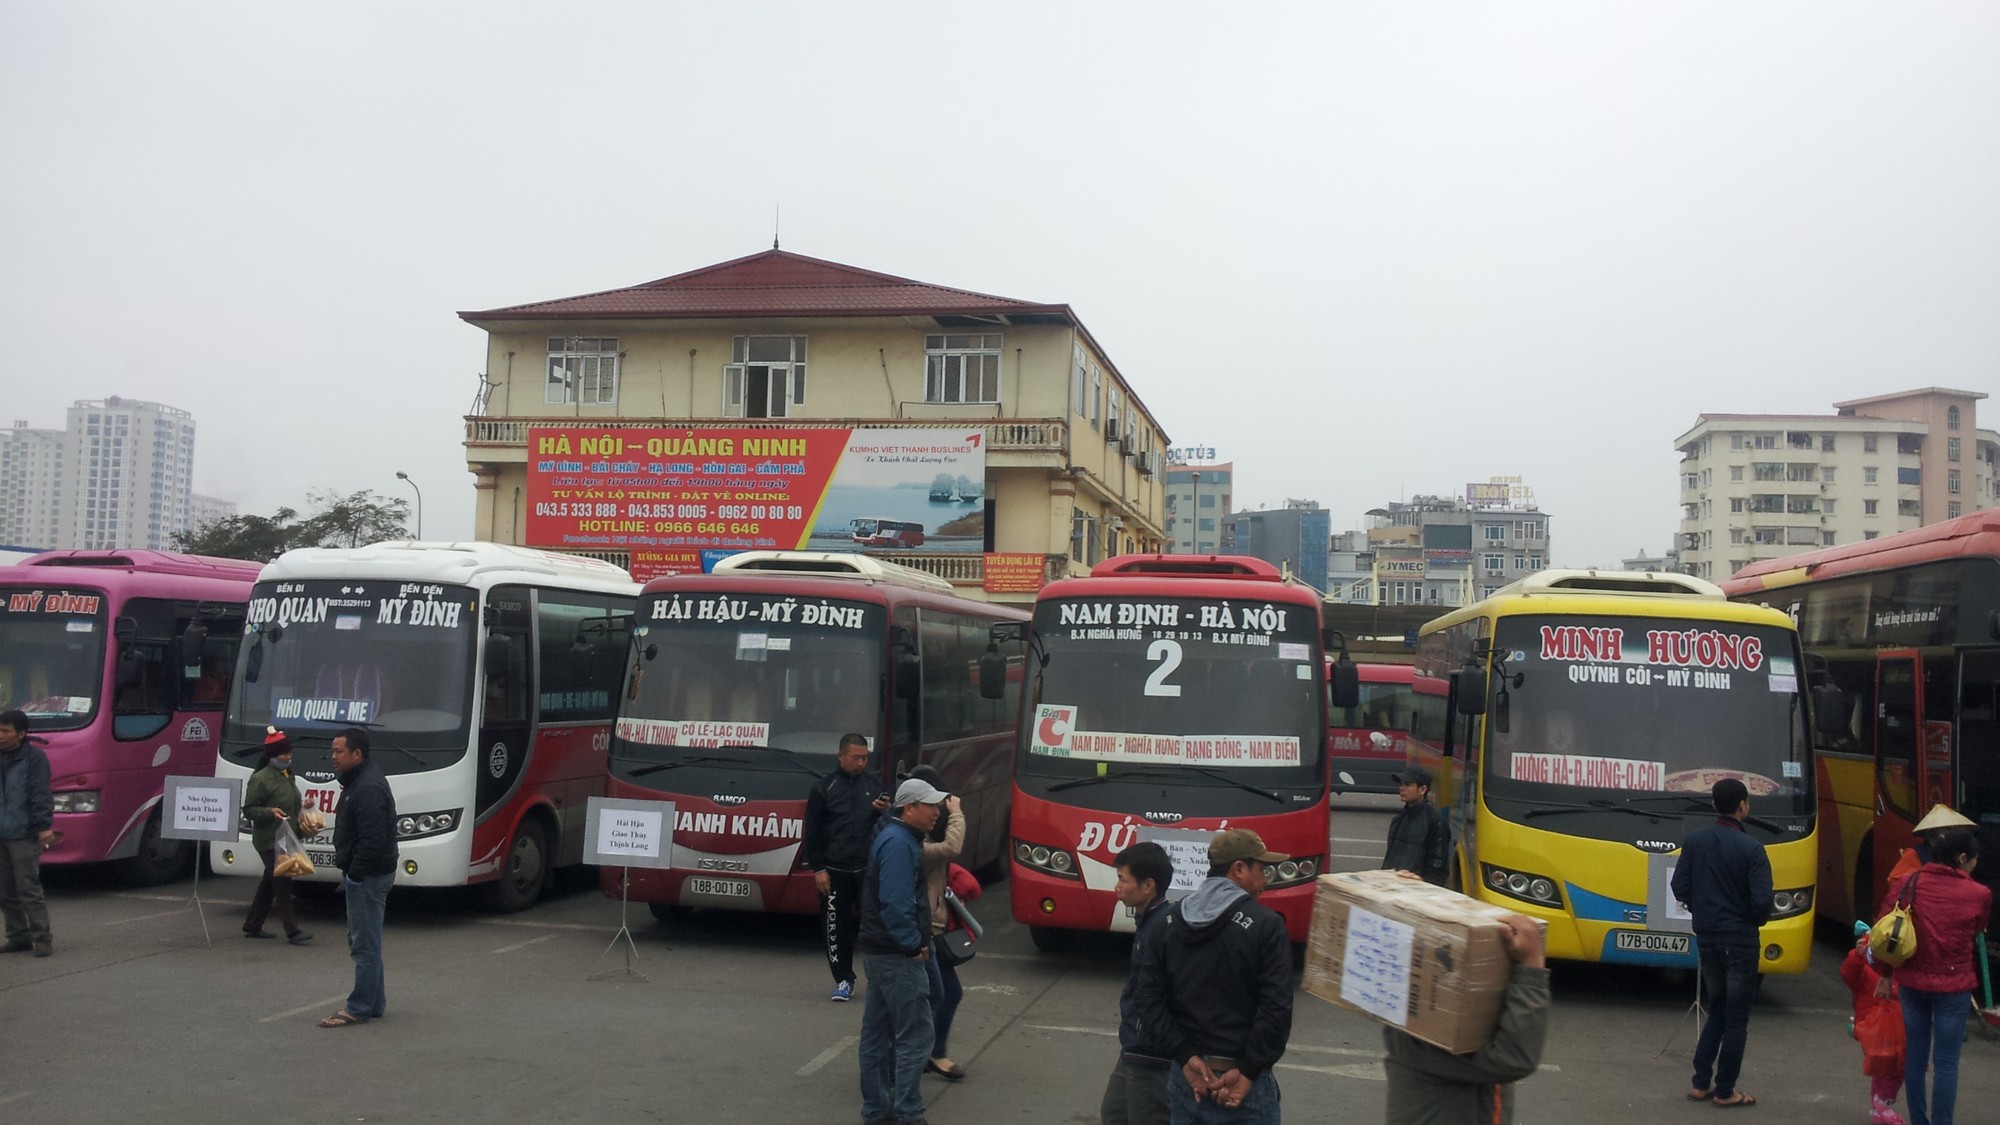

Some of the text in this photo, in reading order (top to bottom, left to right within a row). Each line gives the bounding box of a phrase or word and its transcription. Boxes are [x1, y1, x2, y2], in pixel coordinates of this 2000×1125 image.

[539, 431, 807, 459] HÀ NỘI QUẢNG NINH
[538, 460, 555, 473] MỸ
[557, 460, 582, 473] ĐÌNH
[648, 462, 663, 475] HẠ
[666, 463, 693, 474] LONG
[703, 461, 725, 474] HÒN
[728, 463, 746, 474] GAI
[783, 460, 805, 475] PHẢ
[552, 477, 578, 486] Liên
[759, 480, 789, 490] ngày
[575, 488, 604, 499] VẤN
[628, 489, 671, 499] TRÌNH
[681, 492, 709, 501] ĐẶT
[735, 492, 790, 500] ONLINE:
[536, 502, 802, 520] 043.5 333 888 043.853 0005 0962 00 80 80
[579, 520, 760, 534] HOTLINE: 0966 646 646
[9, 590, 100, 614] MỸ ĐÌNH
[245, 598, 277, 624] NHO
[278, 597, 330, 628] QUAN
[377, 593, 408, 624] MỸ
[409, 594, 462, 628] ĐÌNH
[651, 594, 693, 619] HẢI
[801, 600, 864, 629] ĐÌNH
[1060, 601, 1287, 635] NAM ĐỊNH HÀ NỘI
[1070, 629, 1086, 640] B.X
[1087, 627, 1115, 640] NGHĨA
[1116, 628, 1142, 640] HƯNG
[1165, 631, 1175, 639] 29
[1192, 632, 1202, 640] 13
[1212, 632, 1229, 644] B.X
[1230, 632, 1245, 644] MỸ
[1246, 632, 1270, 646] ĐÌNH
[1541, 626, 1763, 672] MINH HƯƠNG
[1144, 639, 1183, 697] 2
[1569, 663, 1731, 690] QUỲNH CÔI MỸ ĐÌNH
[276, 699, 302, 719] NHO
[303, 700, 338, 721] QUAN
[1041, 708, 1059, 720] Big
[1038, 709, 1071, 746] C
[1032, 746, 1049, 756] NAM
[1071, 735, 1180, 756] NAM ĐỊNH NGHĨA HƯNG
[1185, 741, 1212, 761] RẠNG
[1249, 741, 1272, 759] NAM
[305, 771, 335, 780] SAMCO
[1515, 754, 1549, 783] HƯNG
[201, 795, 218, 803] Quan
[713, 794, 746, 804] SAMCO
[186, 814, 198, 822] Lai
[1145, 812, 1183, 821] SAMCO
[611, 830, 628, 838] Giao
[731, 812, 804, 839] KHÂM
[1076, 815, 1142, 854] ĐỨ
[609, 840, 630, 850] Thịnh
[1636, 840, 1676, 850] SAMCO
[697, 858, 748, 871] ISUZU
[693, 880, 749, 896] 18B-001.98
[1619, 934, 1687, 951] 17B-004.47
